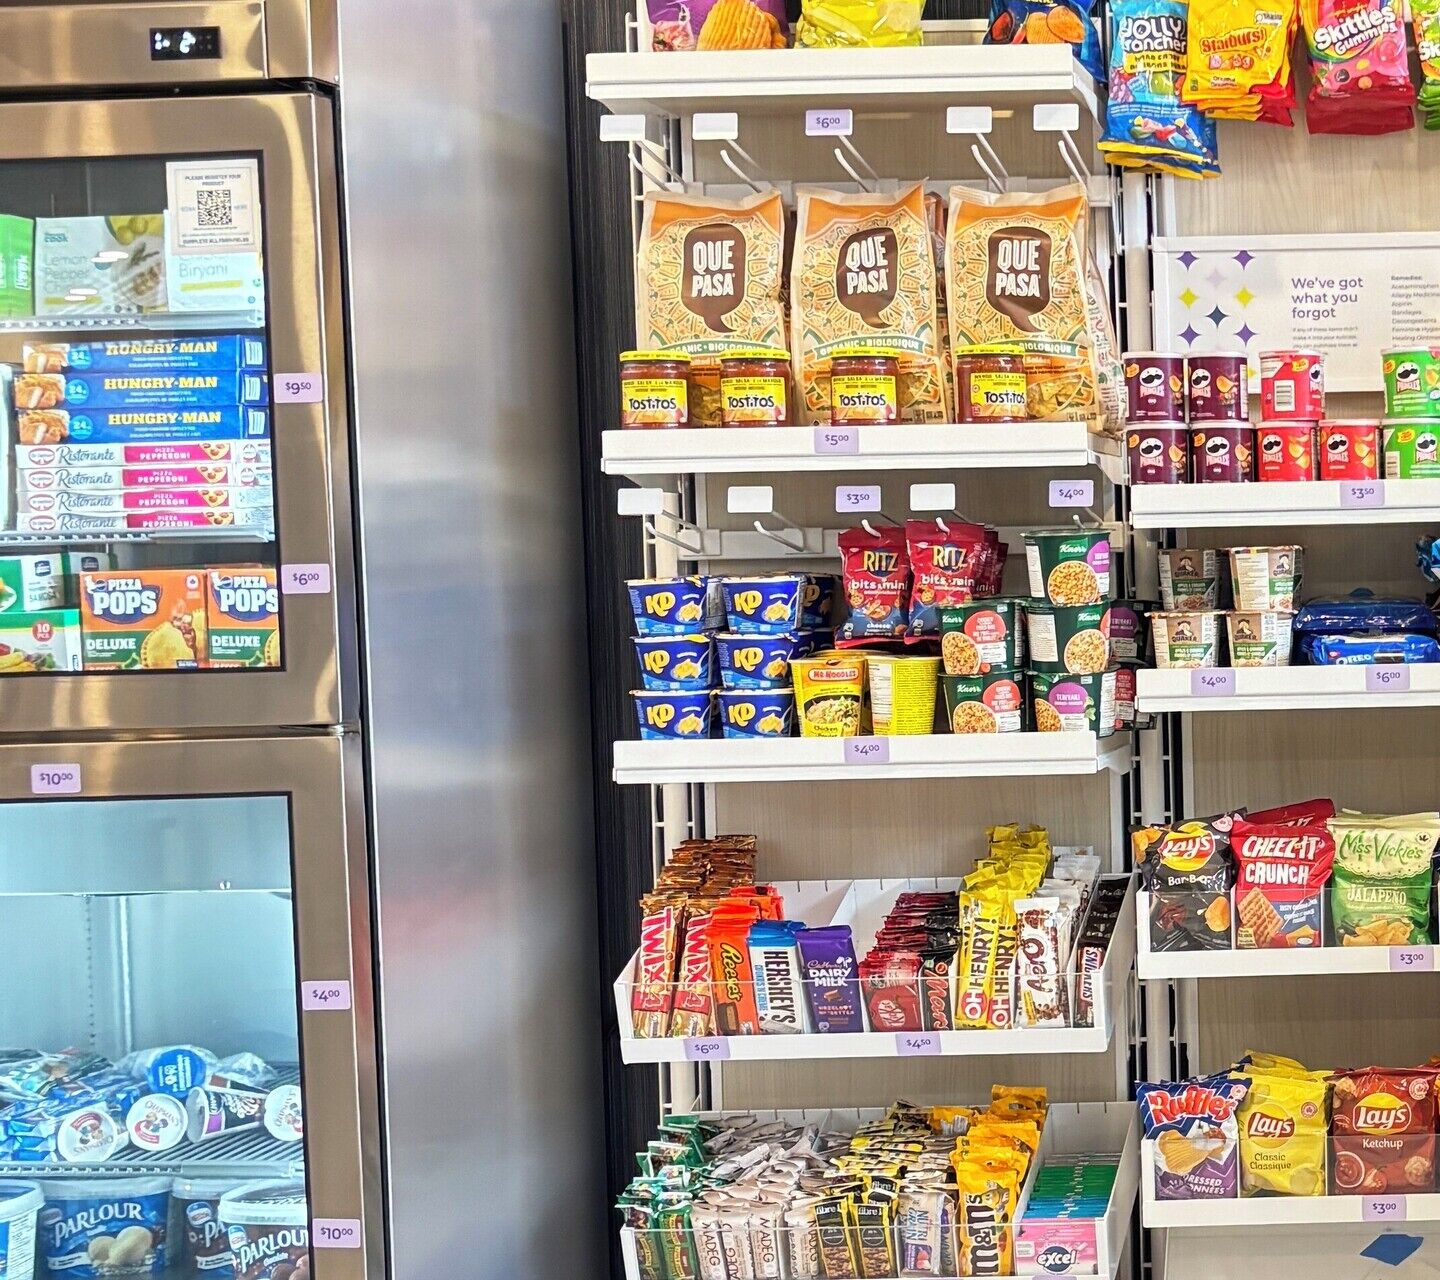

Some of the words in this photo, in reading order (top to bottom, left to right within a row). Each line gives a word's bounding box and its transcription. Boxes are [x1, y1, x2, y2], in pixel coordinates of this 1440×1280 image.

[1313, 6, 1397, 51] Skittles
[1200, 28, 1267, 55] Starburst
[692, 239, 736, 273] QUE
[845, 235, 889, 270] QUE
[996, 238, 1040, 272] QUE
[691, 270, 736, 298] PASA
[846, 266, 890, 296] PASA
[994, 271, 1042, 298] PASA
[1292, 277, 1335, 289] We've
[1339, 277, 1363, 290] got
[1292, 292, 1328, 304] what
[1332, 293, 1358, 306] you
[1292, 307, 1336, 320] forgot
[867, 339, 920, 350] BIOLOGIQUE
[628, 397, 676, 410] TOSTITOS
[727, 394, 775, 409] TOSTITOS
[839, 391, 887, 406] TOSTITOS
[855, 550, 899, 572] RITZ
[932, 546, 972, 570] RITZ
[107, 577, 143, 592] PIZZA
[233, 576, 268, 591] PIZZA
[851, 581, 877, 591] bits
[92, 591, 158, 616] POPS
[220, 590, 278, 614] POPS
[86, 638, 136, 651] DELUXE
[212, 635, 261, 648] DELUXE
[1242, 835, 1320, 860] CHEEZ-IT
[1339, 831, 1371, 860] Miss
[1373, 834, 1424, 864] Vickie's
[1245, 862, 1309, 884] CRUNCH
[1347, 883, 1406, 906] JALAPEÑO
[642, 907, 672, 990] TWIX
[969, 917, 997, 988] HENRY!
[719, 942, 745, 1002] Reese's
[809, 967, 852, 978] DAIRY
[995, 924, 1019, 999] HENRY!
[1021, 938, 1054, 993] Aero
[763, 950, 796, 1025] HERSHEY'S
[814, 976, 849, 987] MILK
[964, 991, 983, 1020] OH
[991, 999, 1010, 1025] OH
[1146, 1086, 1239, 1126] Ruffles
[1356, 1107, 1407, 1129] Lay's
[1249, 1112, 1293, 1138] Lay's
[1363, 1138, 1403, 1150] Ketchup
[1250, 1161, 1291, 1171] Classique
[1254, 1152, 1286, 1161] Classic
[54, 1203, 145, 1240] PARLOUR
[1037, 1247, 1077, 1265] excel
